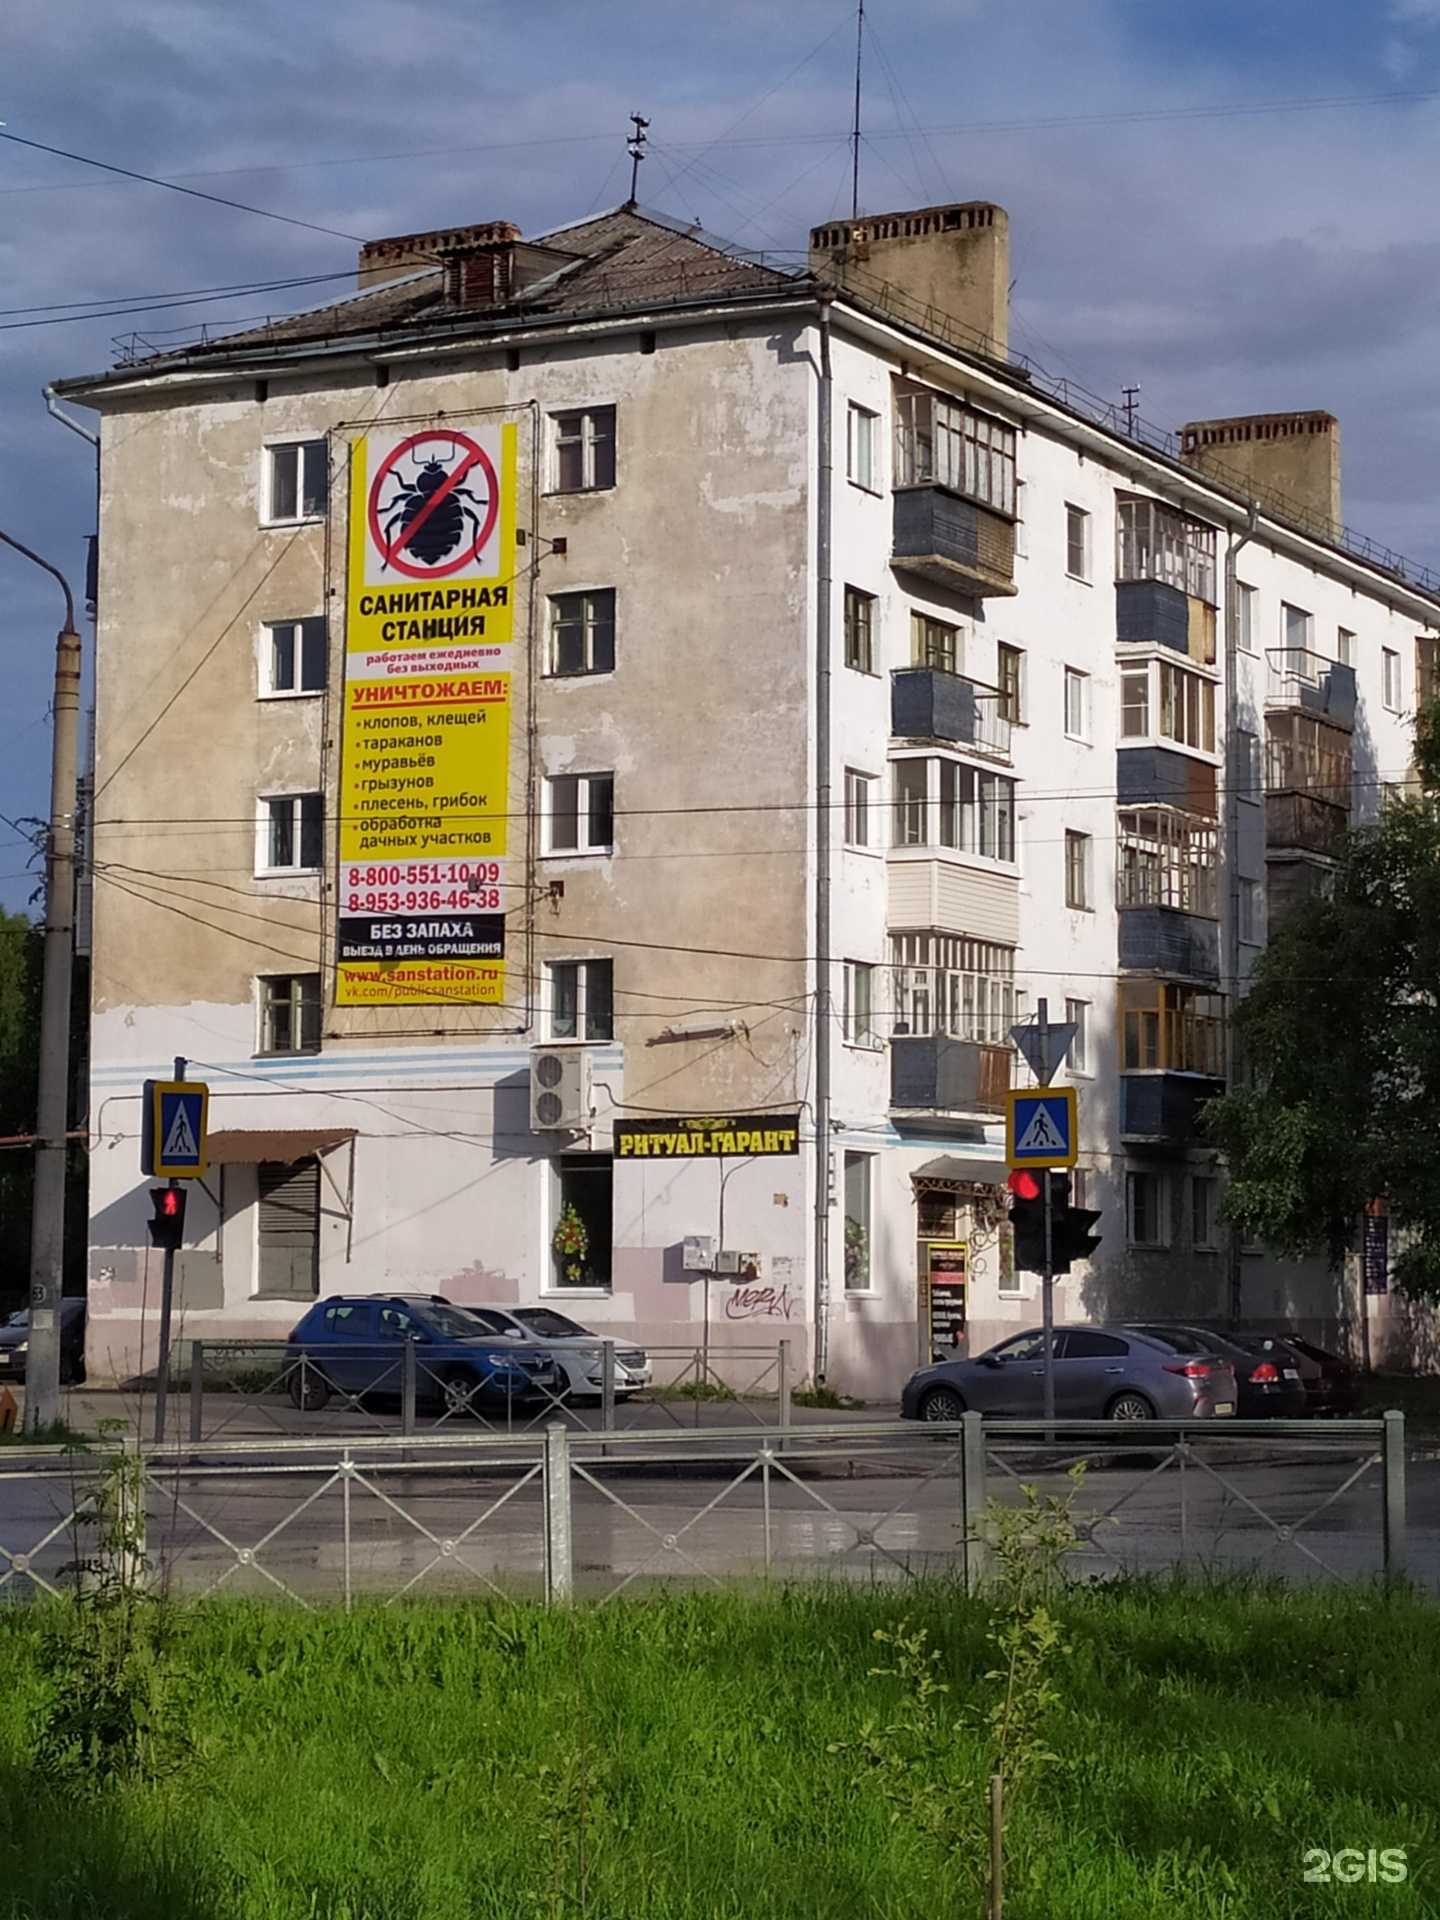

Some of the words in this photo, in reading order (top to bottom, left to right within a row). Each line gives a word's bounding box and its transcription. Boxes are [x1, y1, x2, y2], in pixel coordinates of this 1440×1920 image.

[360, 586, 508, 616] САНИТАРНАЯ
[381, 615, 485, 641] СТАНЦИЯ
[366, 652, 426, 666] работаем
[430, 647, 501, 661] ежедневно
[387, 663, 408, 674] без
[411, 660, 479, 673] выходных
[353, 680, 508, 702] УНИЧТОЖАЕМ:
[363, 714, 422, 729] клопов,
[427, 709, 486, 726] клещей
[363, 734, 443, 752] тараканов
[362, 753, 435, 773] муравьёв
[361, 776, 434, 793] грызунов
[361, 797, 428, 811] плесень,
[432, 792, 487, 810] грибок
[360, 815, 442, 833] обработка
[360, 835, 417, 850] дачных
[421, 831, 491, 848] участков
[348, 863, 500, 887] 8-800-551-10-09
[348, 889, 500, 912] 8-953-936-46-38
[370, 924, 401, 940] БЕЗ
[406, 922, 474, 938] ЗАПАХА
[427, 942, 501, 956] ОБРАЩЕНИЯ
[344, 966, 499, 983] www.sanstation.ru
[619, 1130, 796, 1156] РИТУАЛ-ГАРАНТ
